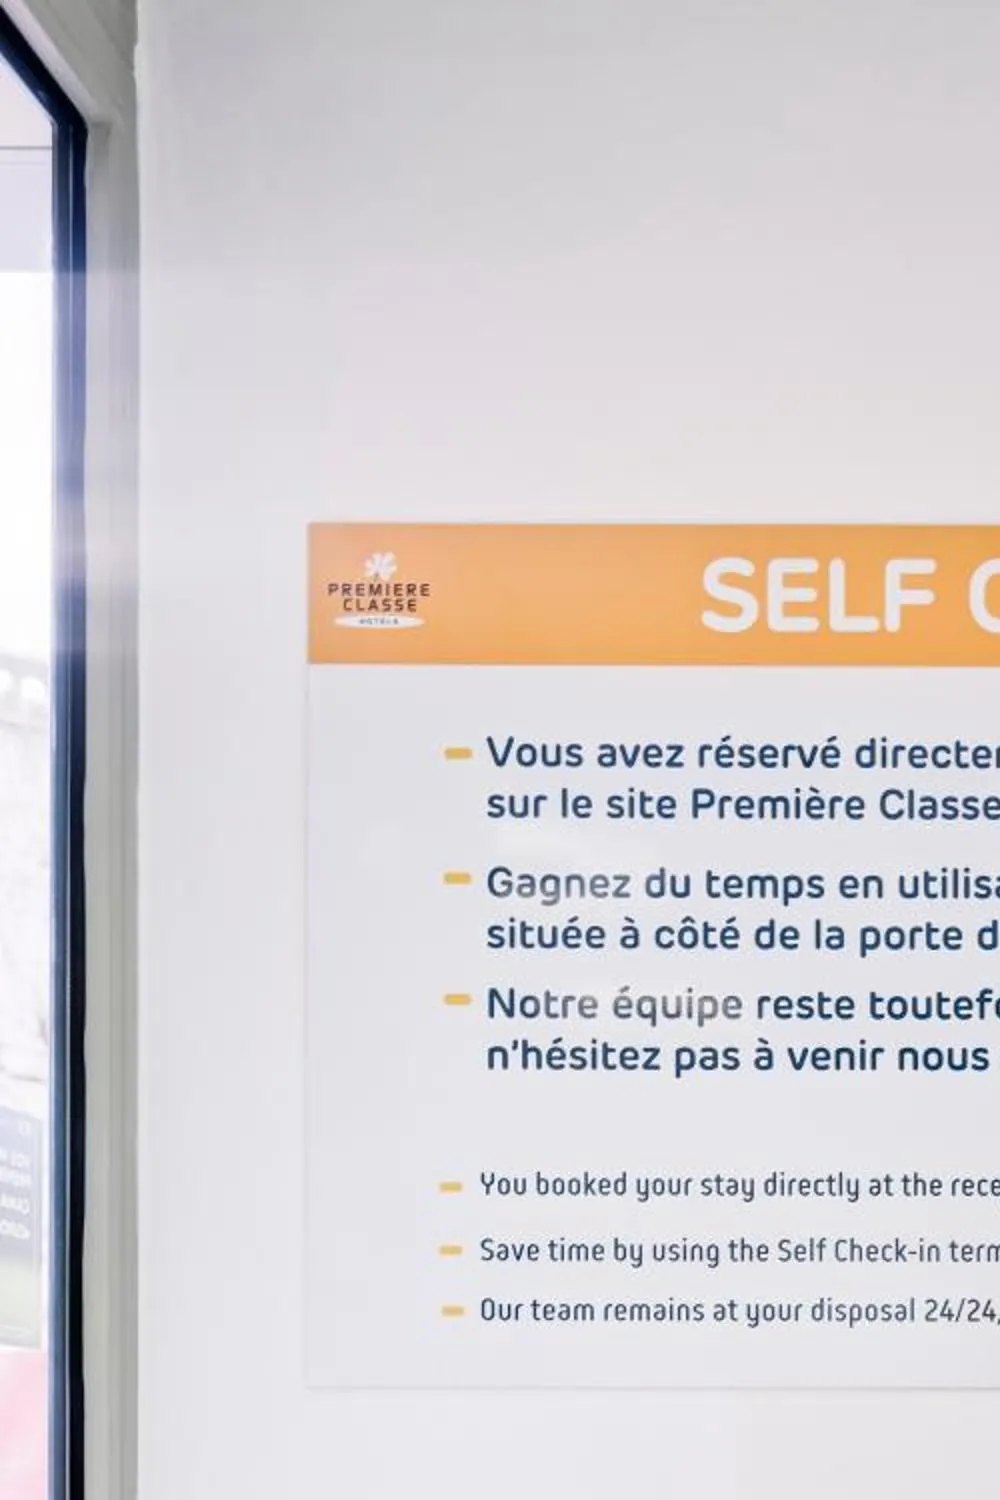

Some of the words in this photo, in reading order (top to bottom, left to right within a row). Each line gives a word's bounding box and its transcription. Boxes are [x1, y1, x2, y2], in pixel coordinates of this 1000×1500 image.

[327, 583, 431, 597] PREMIERE
[343, 598, 417, 612] CLASSE
[702, 557, 936, 633] SELF
[485, 735, 585, 769] Vous
[596, 742, 686, 769] avez
[697, 734, 842, 770] réservé
[486, 793, 549, 820] sur
[560, 786, 594, 820] le
[605, 786, 678, 820] site
[691, 784, 866, 821] Première
[486, 865, 632, 907] Gagnez
[644, 866, 692, 900] du
[705, 869, 826, 908] temps
[837, 874, 885, 900] en
[485, 915, 607, 950] située
[618, 915, 641, 951] à
[653, 915, 741, 951] côté
[753, 917, 801, 952] de
[814, 917, 846, 952] la
[859, 920, 964, 959] porte
[487, 986, 599, 1020] Notre
[611, 984, 744, 1029] équipe
[756, 990, 856, 1022] reste
[486, 1036, 662, 1072] n'hésitez
[673, 1045, 742, 1080] pas
[752, 1036, 775, 1072] à
[786, 1037, 886, 1072] venir
[897, 1046, 991, 1073] nous
[479, 1171, 528, 1197] You
[535, 1170, 628, 1197] booked
[635, 1176, 694, 1204] your
[699, 1173, 756, 1204] stay
[762, 1170, 861, 1204] directly
[868, 1173, 895, 1198] at
[899, 1170, 944, 1198] the
[479, 1236, 541, 1263] Save
[547, 1236, 606, 1263] time
[613, 1236, 644, 1270] by
[651, 1236, 721, 1270] using
[727, 1236, 770, 1263] the
[777, 1236, 828, 1264] Self
[833, 1236, 942, 1264] Check-in
[479, 1296, 525, 1323] Our
[529, 1298, 596, 1322] team
[603, 1296, 706, 1323] remains
[712, 1298, 739, 1323] at
[745, 1302, 804, 1329] your
[810, 1296, 916, 1329] disposal
